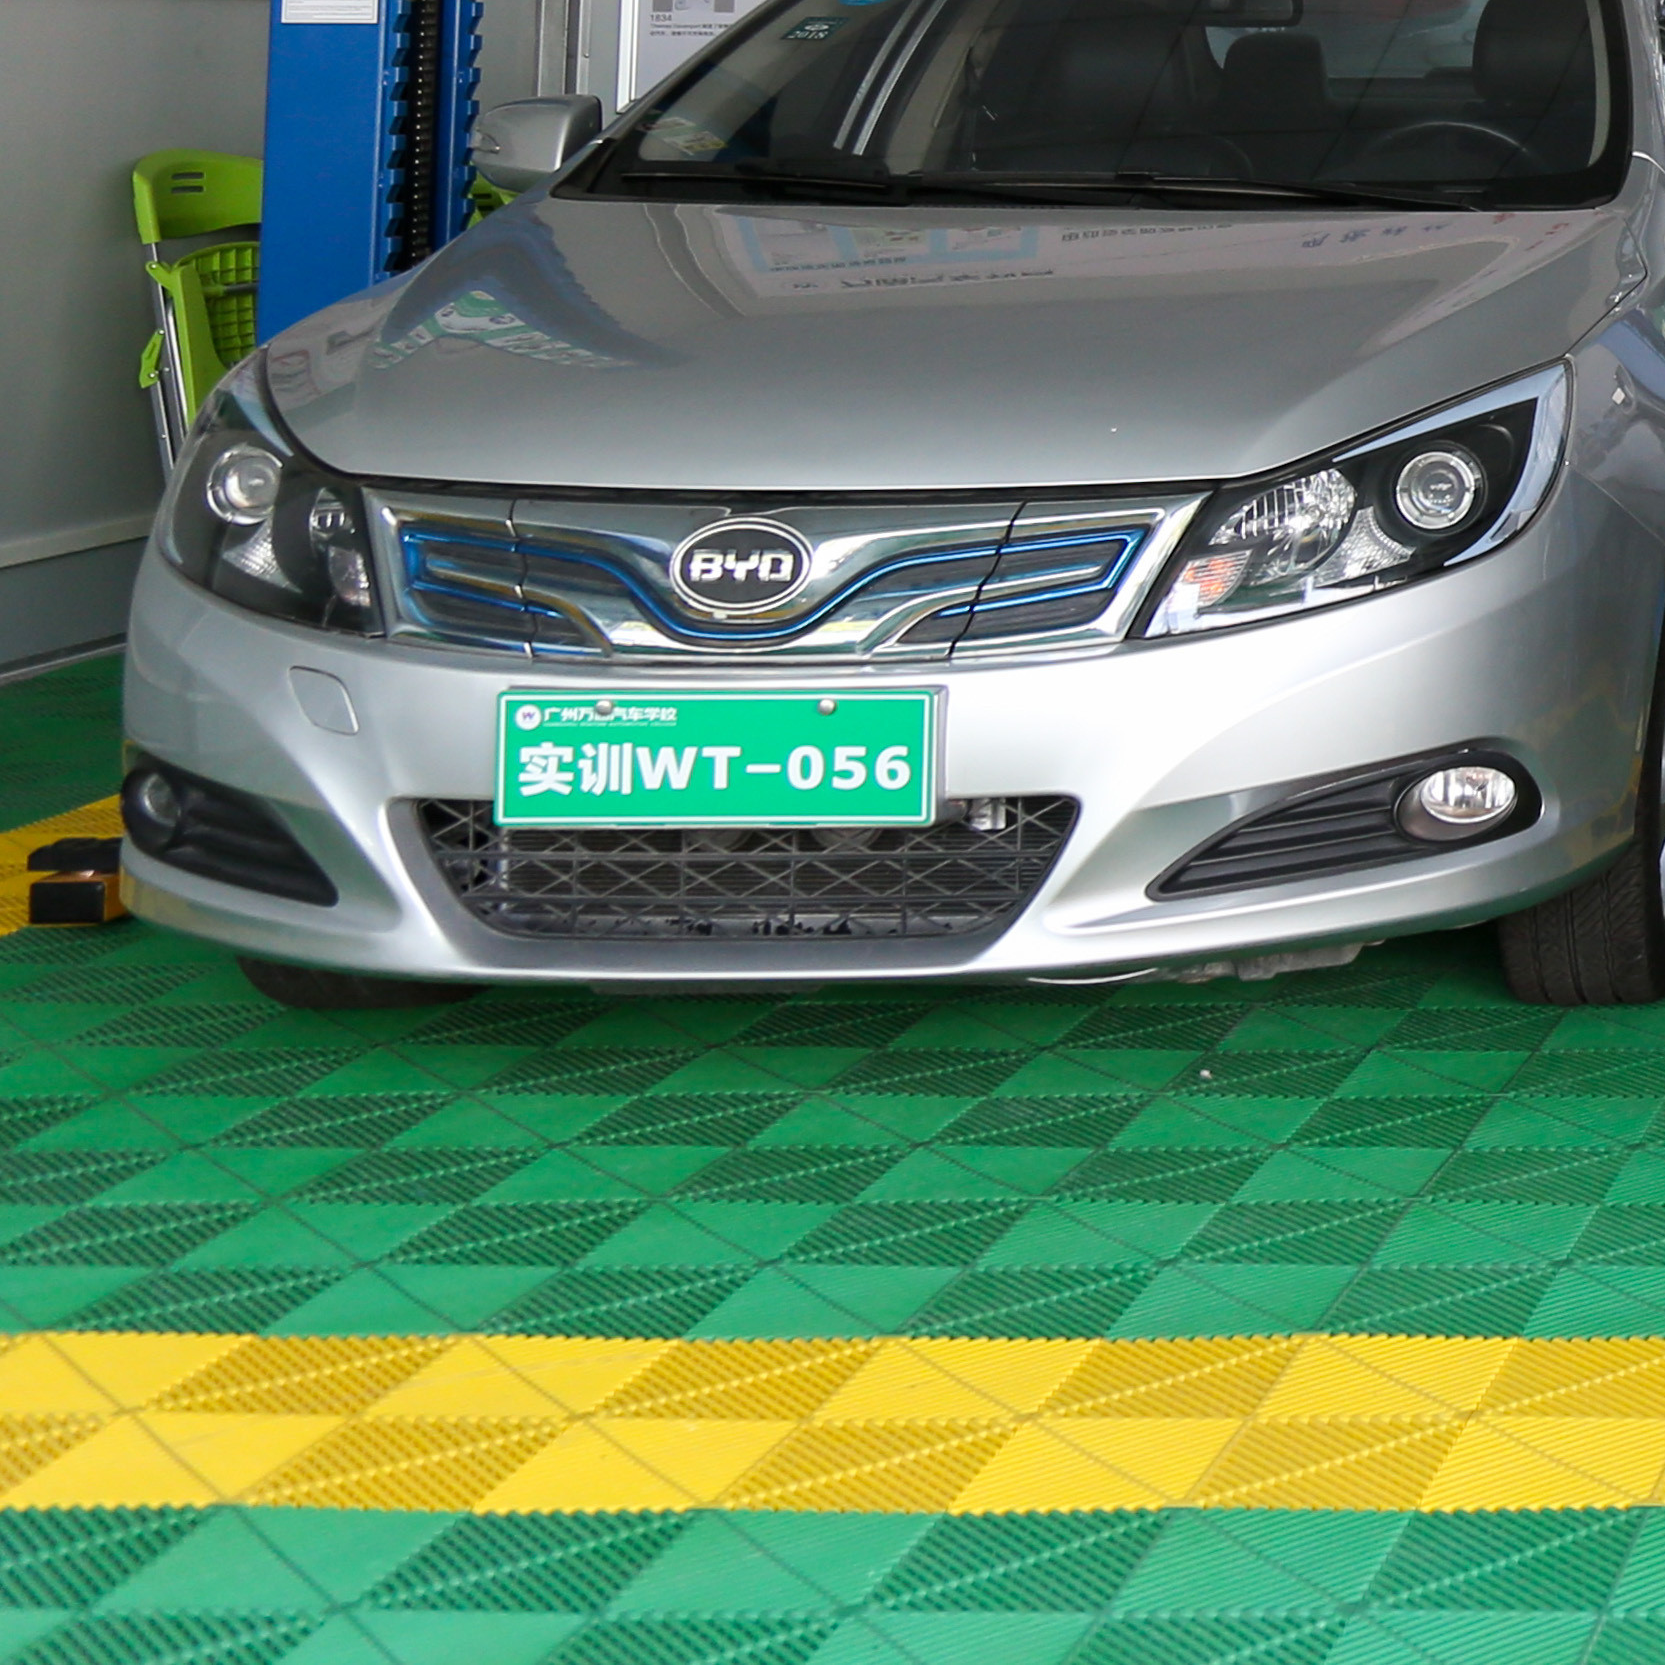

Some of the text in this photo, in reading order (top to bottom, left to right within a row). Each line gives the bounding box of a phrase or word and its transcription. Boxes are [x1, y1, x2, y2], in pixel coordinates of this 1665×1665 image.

[650, 13, 672, 23] 1834
[688, 548, 795, 583] BYD
[518, 741, 912, 797] 实训WT-056
